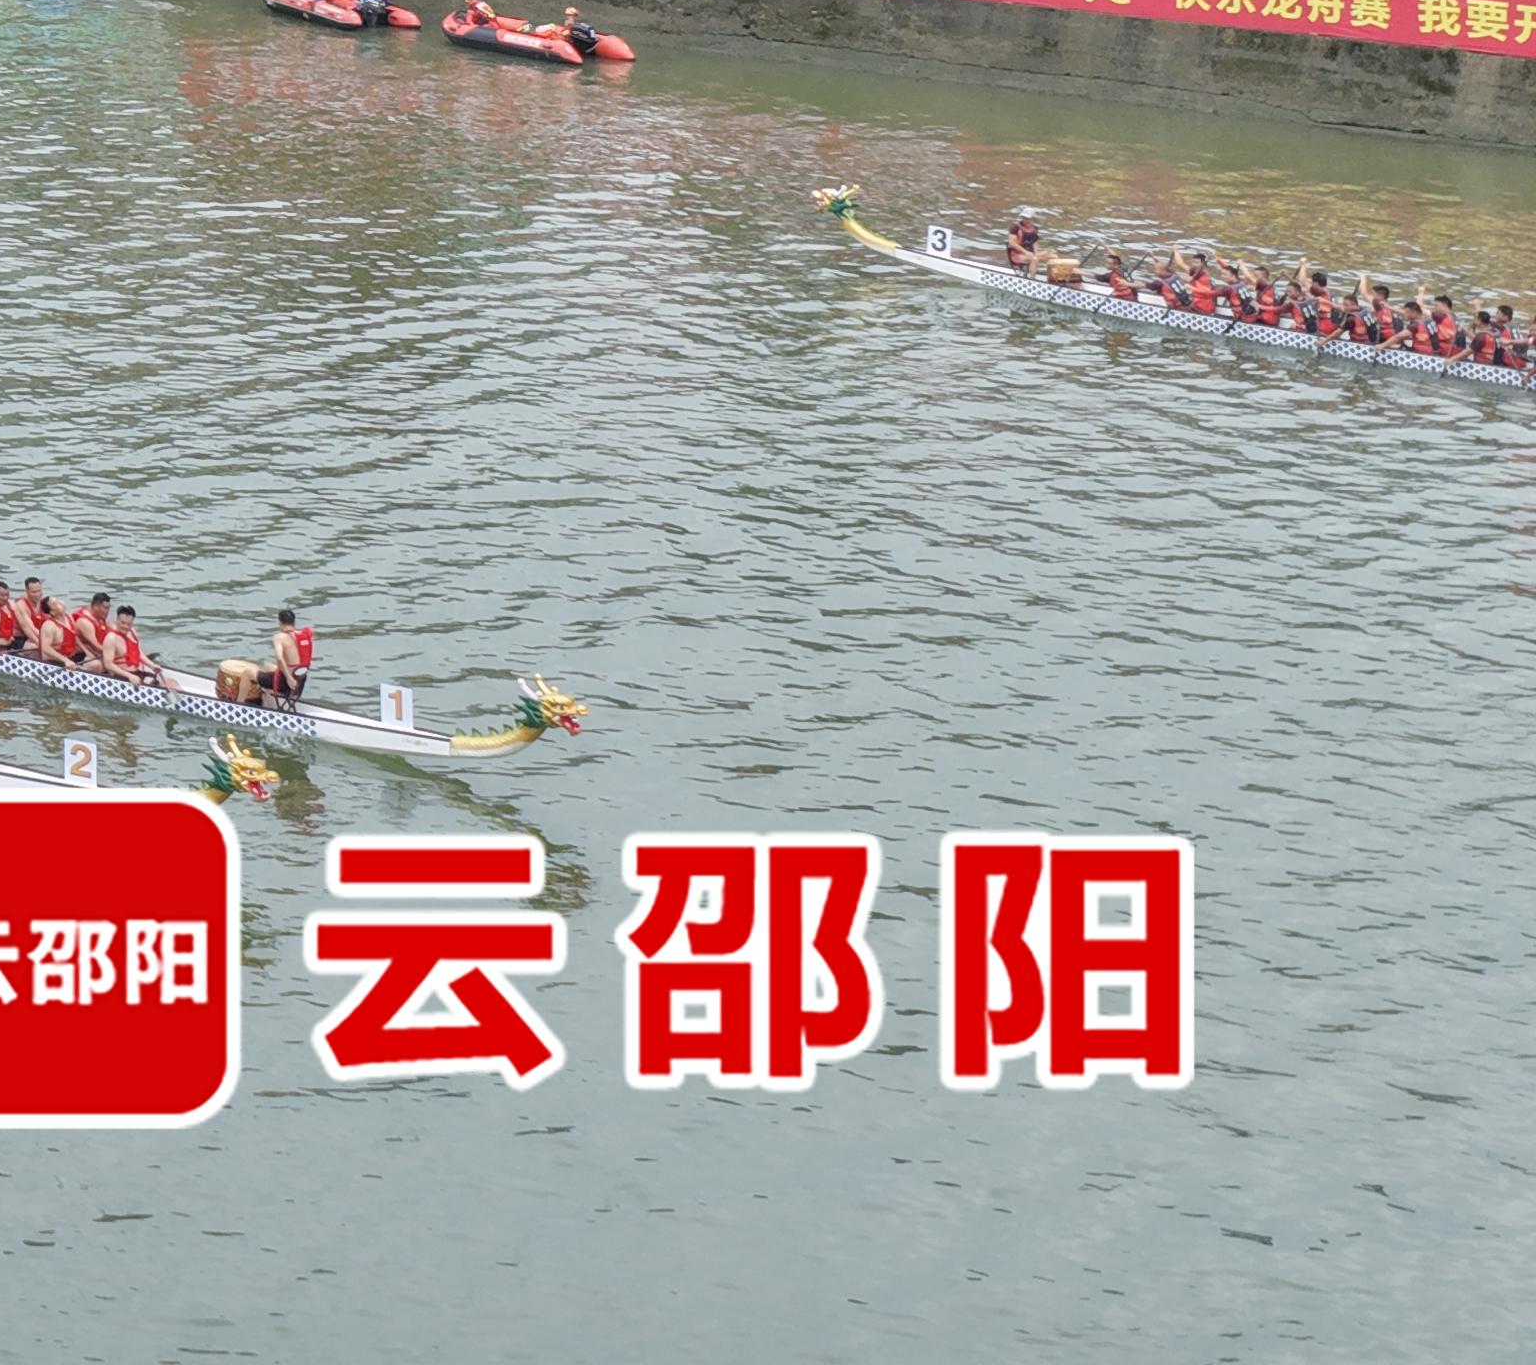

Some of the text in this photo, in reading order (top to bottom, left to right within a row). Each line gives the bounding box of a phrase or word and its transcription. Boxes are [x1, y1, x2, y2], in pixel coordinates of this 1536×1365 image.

[931, 229, 948, 252] 3
[387, 689, 403, 720] 1
[69, 743, 92, 779] 2
